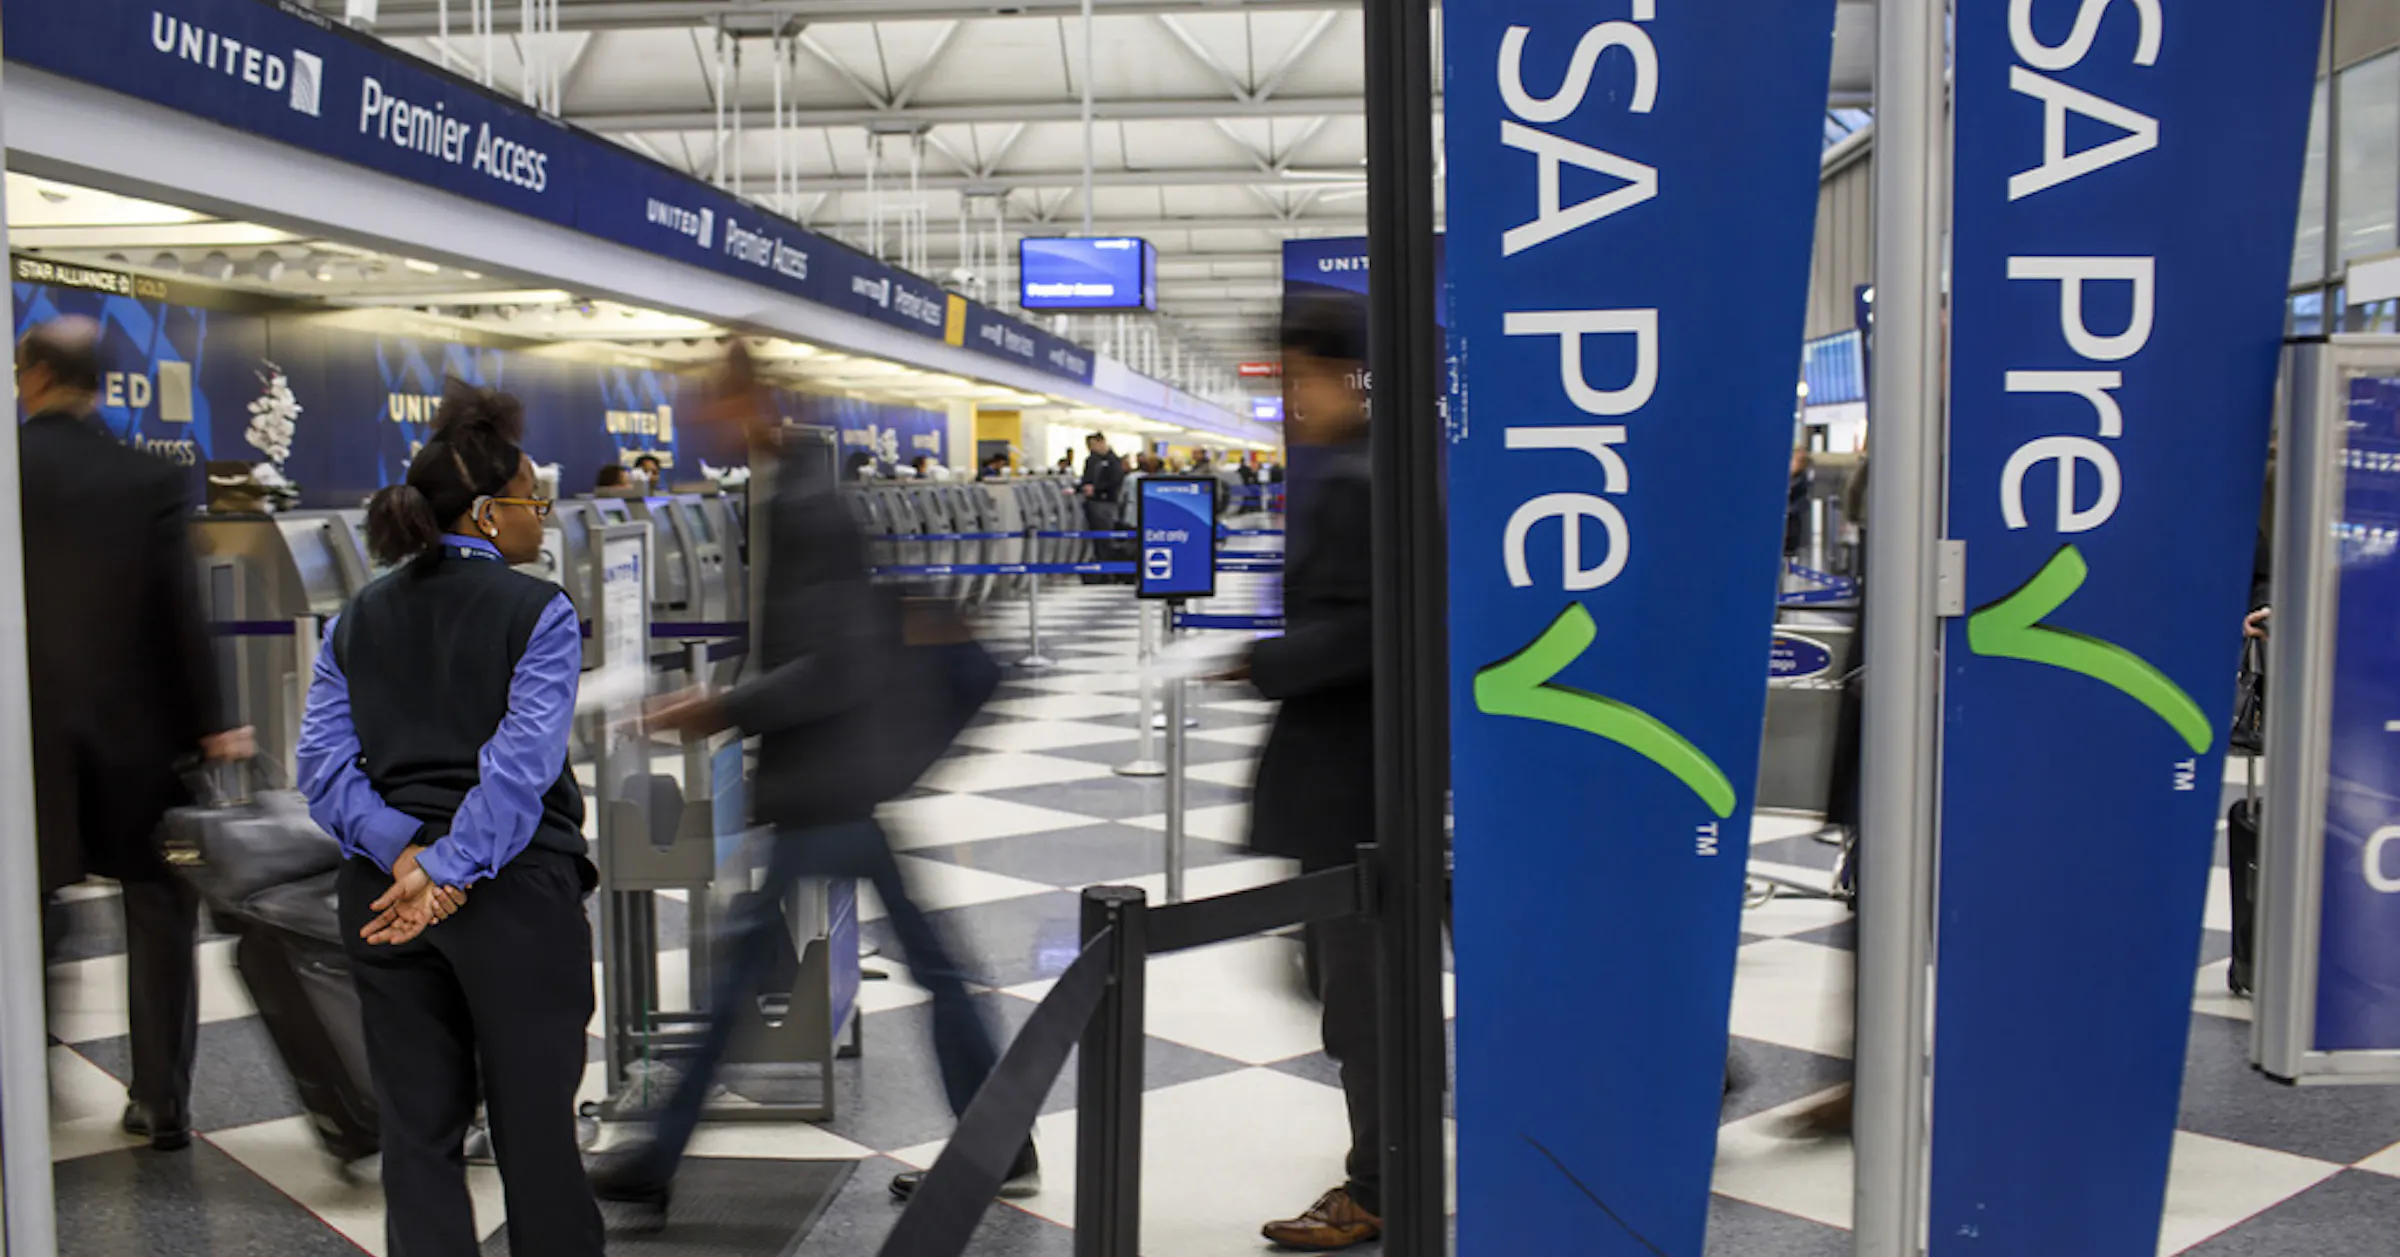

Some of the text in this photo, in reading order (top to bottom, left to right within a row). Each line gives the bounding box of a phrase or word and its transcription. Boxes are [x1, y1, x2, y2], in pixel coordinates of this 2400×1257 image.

[152, 11, 548, 193] UNITED Premier Access
[647, 197, 699, 236] UNITED
[18, 259, 53, 280] STAR
[56, 264, 117, 291] ALLIANCE
[1497, 0, 1658, 590] SA Pre
[2001, 256, 2155, 532] Pre
[1145, 529, 1189, 545] Exit only
[2174, 757, 2195, 791] TM
[1696, 821, 1719, 857] TM
